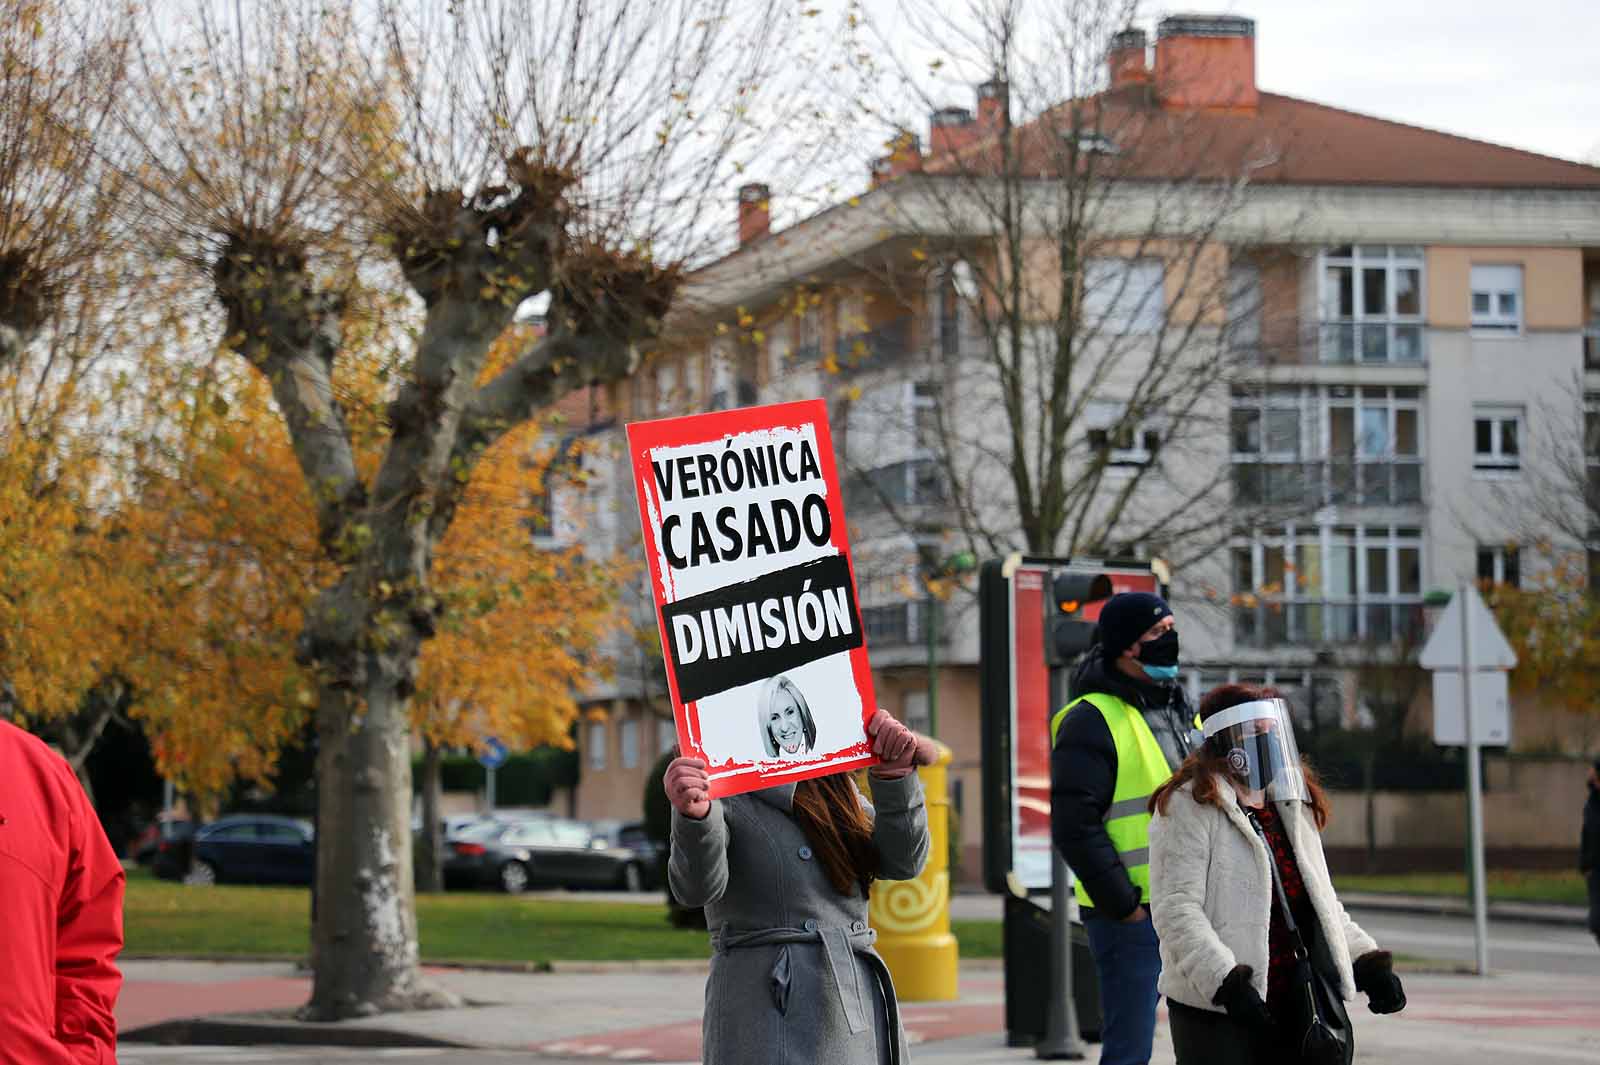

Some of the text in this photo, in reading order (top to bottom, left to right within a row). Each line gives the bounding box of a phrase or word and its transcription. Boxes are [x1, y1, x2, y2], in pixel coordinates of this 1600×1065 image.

[652, 440, 821, 501] VERÓNICA
[661, 493, 831, 569] CASADO
[672, 579, 853, 665] DIMISIÓN
